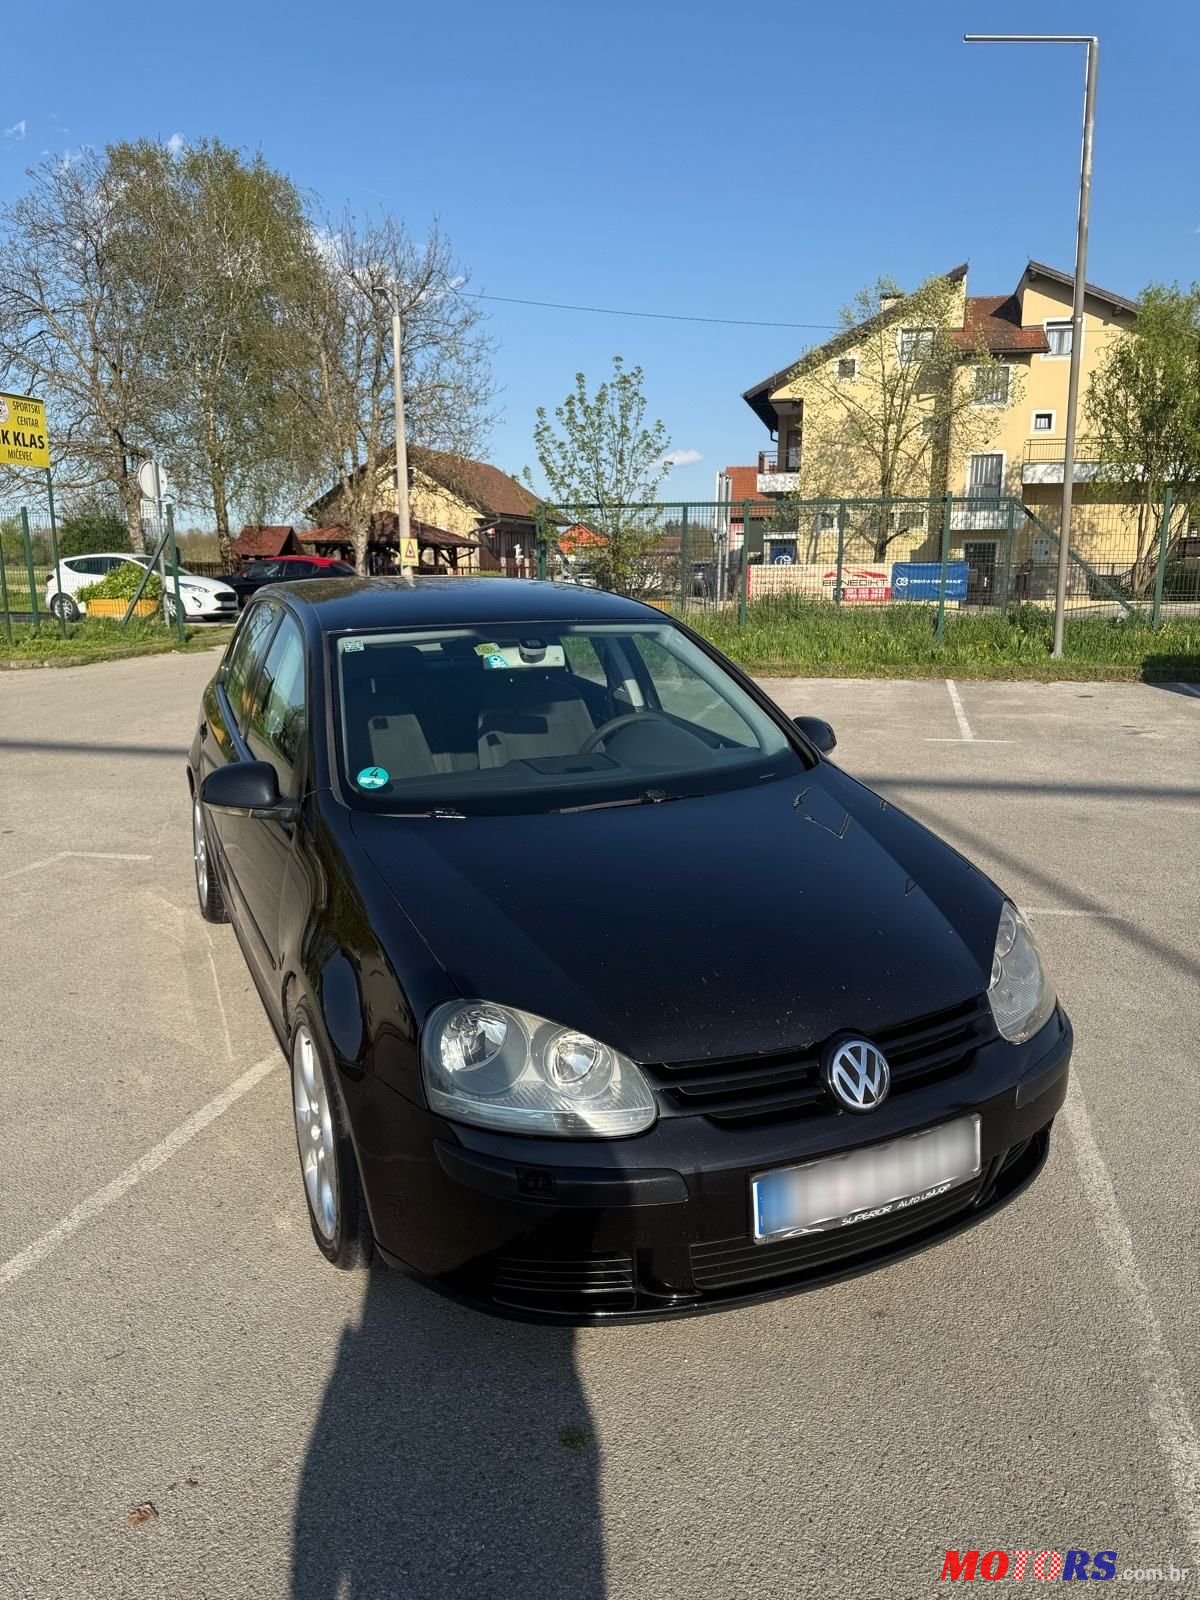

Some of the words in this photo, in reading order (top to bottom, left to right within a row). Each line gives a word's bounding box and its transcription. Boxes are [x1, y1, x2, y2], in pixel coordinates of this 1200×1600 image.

[12, 400, 41, 414] SPORTSKI
[16, 415, 40, 428] CENTAR
[13, 431, 45, 449] KLAS
[7, 448, 33, 461] MIČEVEC
[369, 767, 378, 778] 4
[841, 1205, 892, 1226] SUPERIOR
[897, 1196, 920, 1209] Auto
